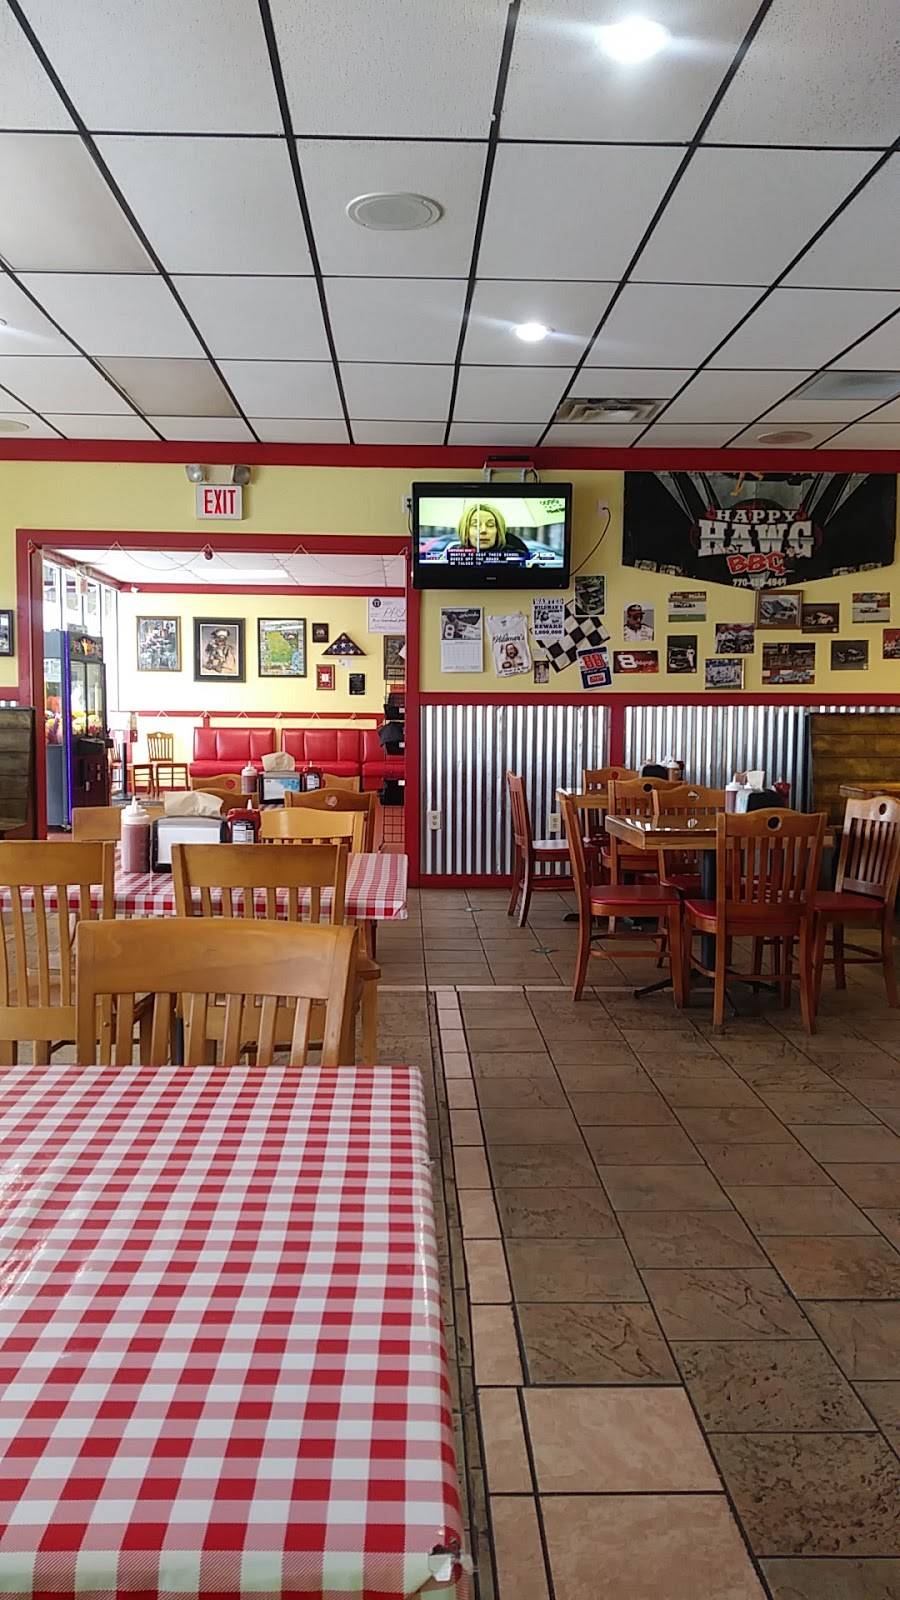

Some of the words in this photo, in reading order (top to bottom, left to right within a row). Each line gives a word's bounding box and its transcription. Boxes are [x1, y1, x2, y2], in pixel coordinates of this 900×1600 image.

[204, 489, 236, 515] EXIT
[716, 509, 797, 524] HAPPY
[698, 519, 815, 558] HAWG
[726, 552, 786, 576] BBQ
[617, 654, 638, 669] 8
